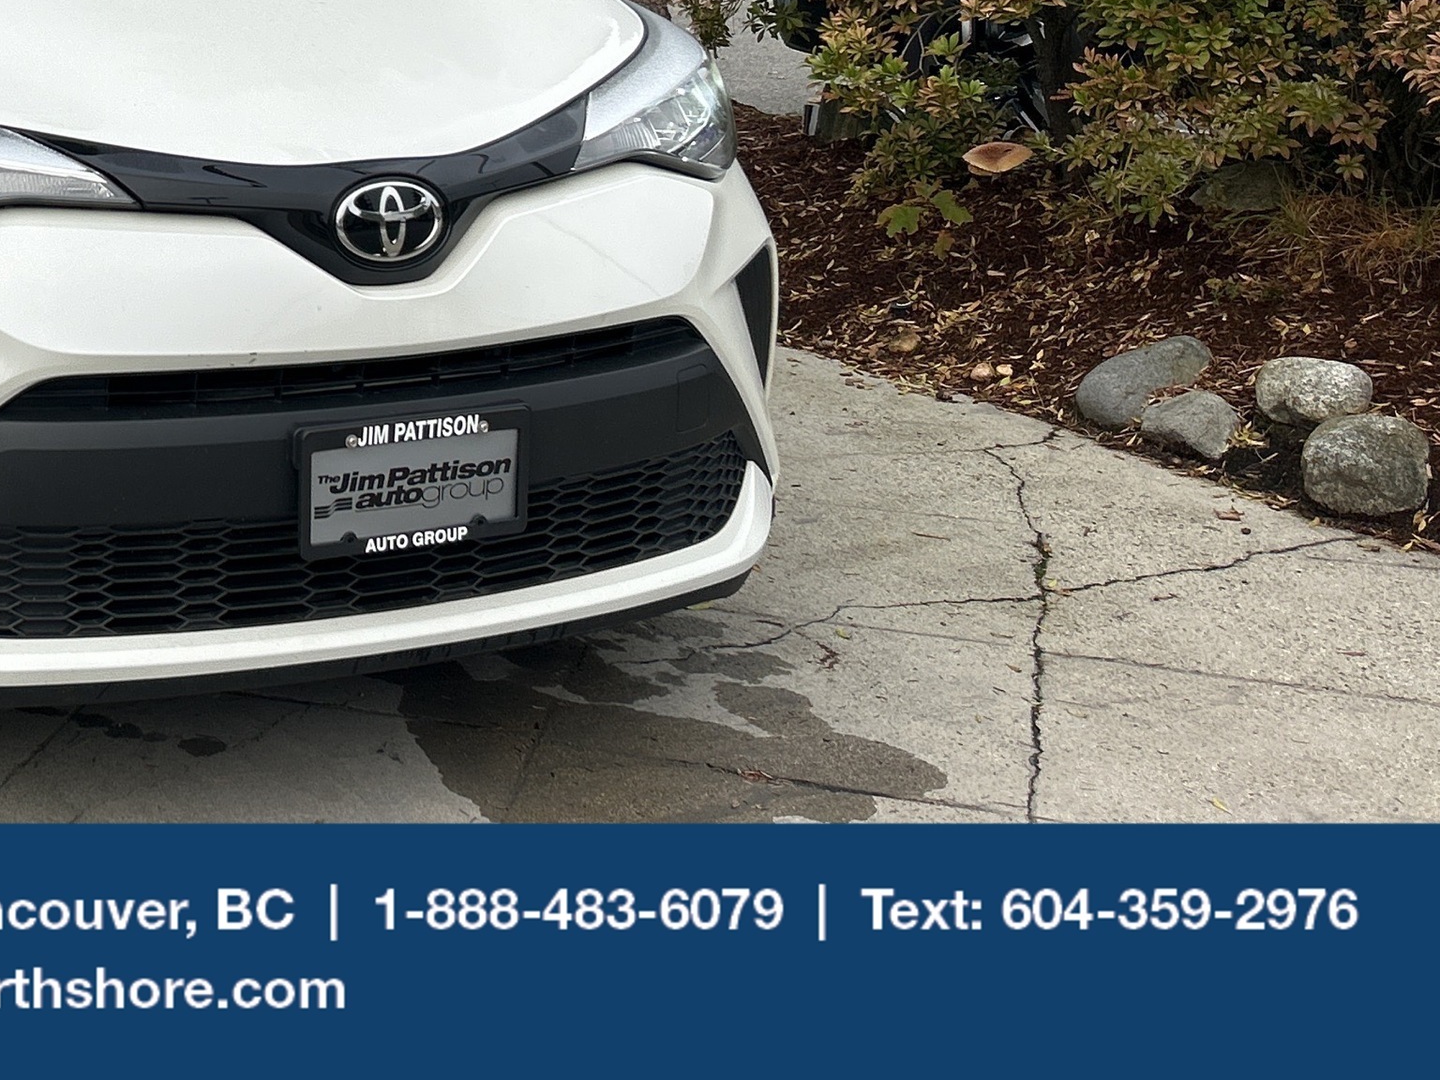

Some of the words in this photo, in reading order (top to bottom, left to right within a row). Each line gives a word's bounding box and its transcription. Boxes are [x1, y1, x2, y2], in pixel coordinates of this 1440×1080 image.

[357, 424, 389, 447] JIM
[394, 414, 480, 443] PATTISON
[317, 474, 340, 484] The
[365, 533, 408, 554] AUTO
[412, 526, 468, 547] GROUP
